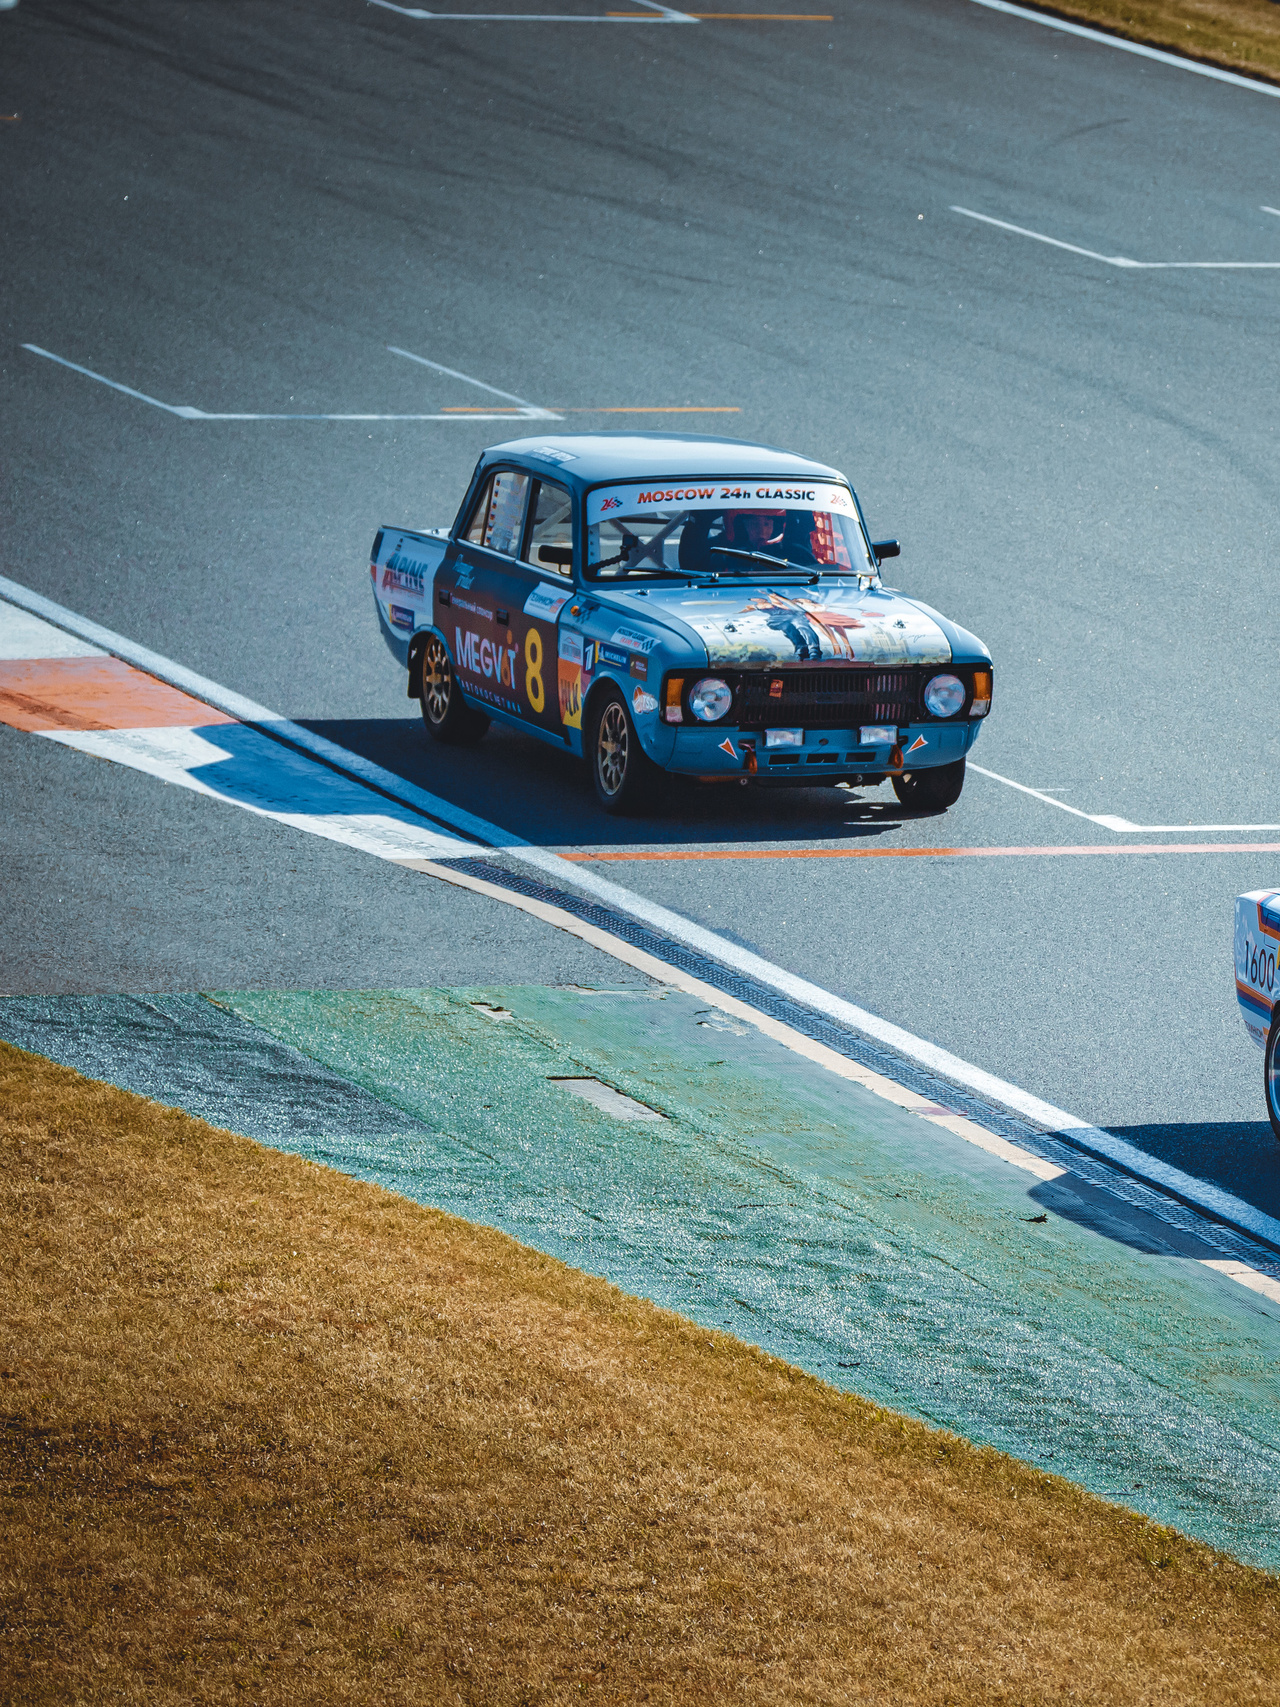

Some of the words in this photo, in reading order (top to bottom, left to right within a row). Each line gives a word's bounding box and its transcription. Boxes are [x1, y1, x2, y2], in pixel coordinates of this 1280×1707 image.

[637, 488, 715, 504] MOSCOW
[720, 487, 750, 499] 24h
[755, 487, 815, 501] CLASSIC
[525, 628, 545, 713] 8
[604, 651, 627, 664] MICHELIN
[1245, 940, 1275, 992] 1600
